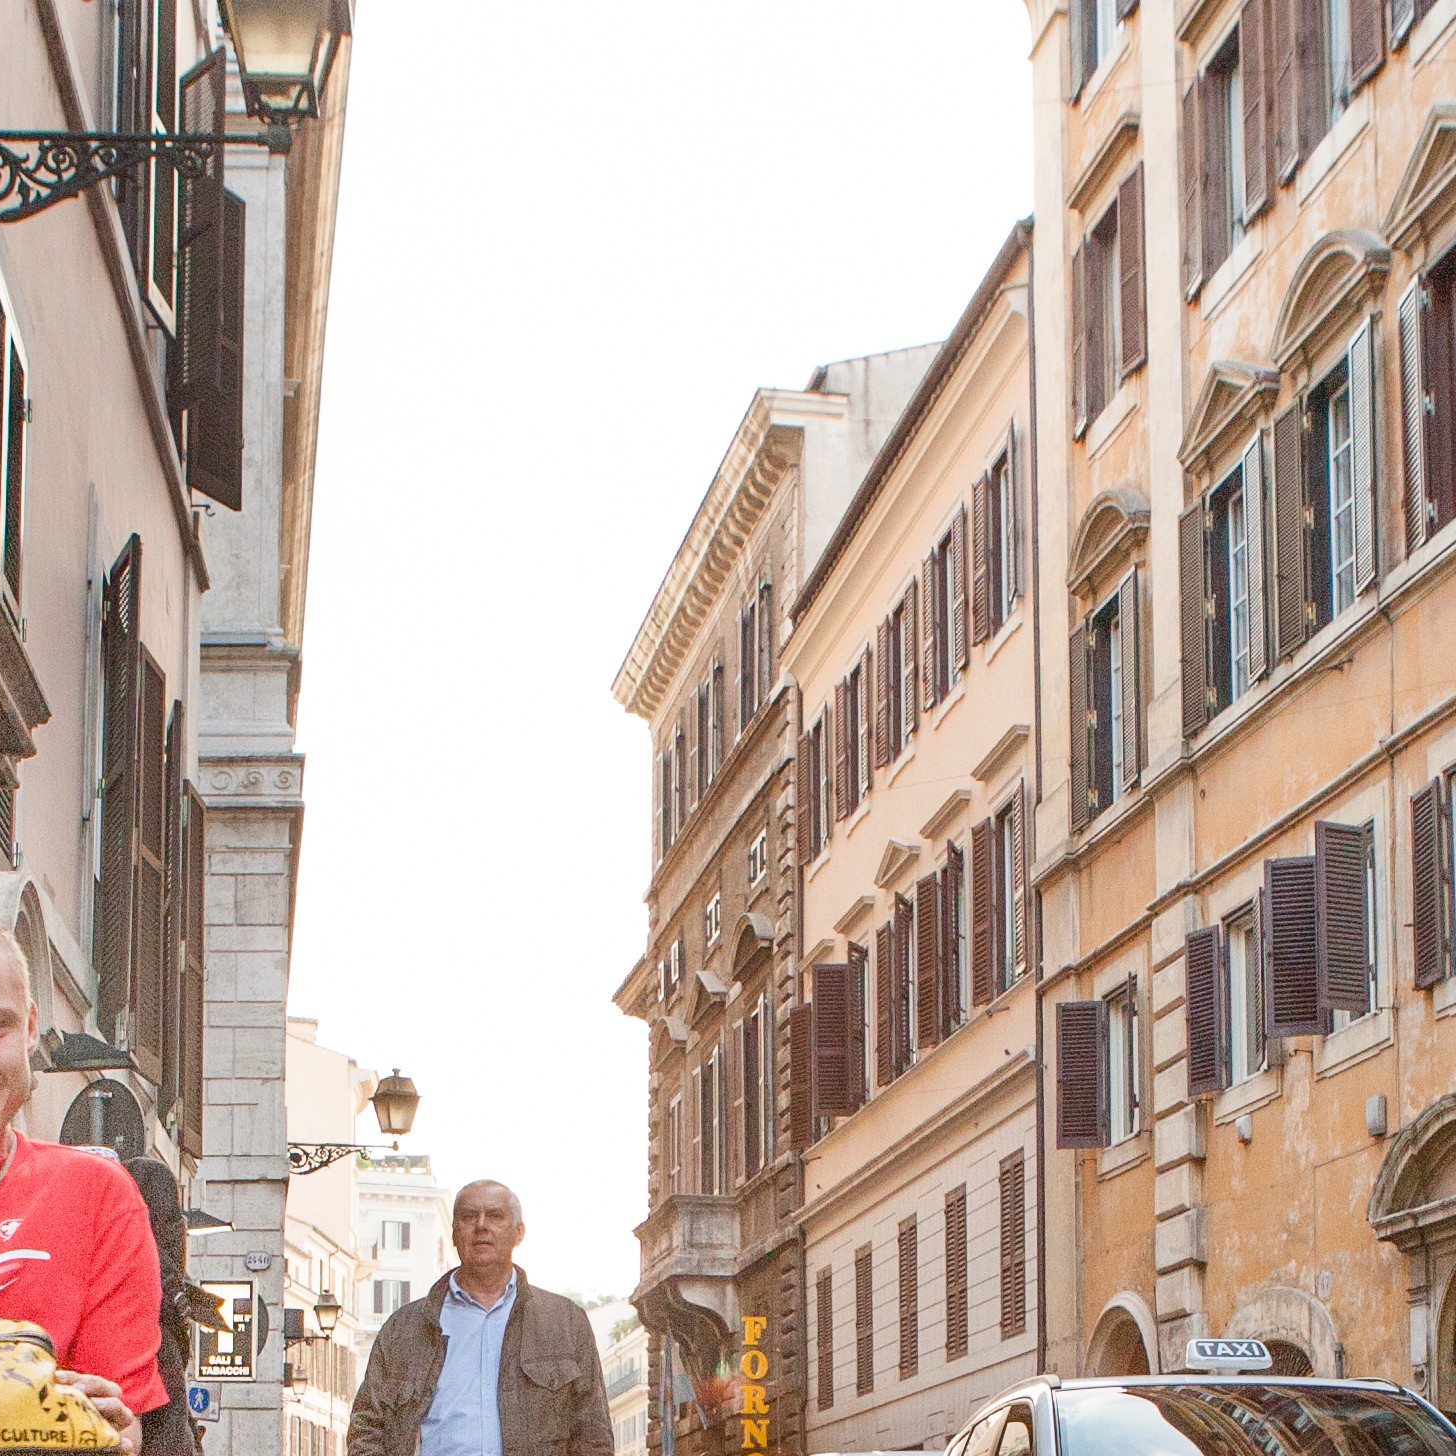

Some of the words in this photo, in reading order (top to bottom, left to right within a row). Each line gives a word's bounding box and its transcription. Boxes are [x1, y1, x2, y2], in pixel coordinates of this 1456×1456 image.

[1197, 1342, 1261, 1357] TAXI
[208, 1355, 231, 1365] SALI
[200, 1366, 250, 1376] TABACCHI
[0, 1428, 68, 1443] CULTURE
